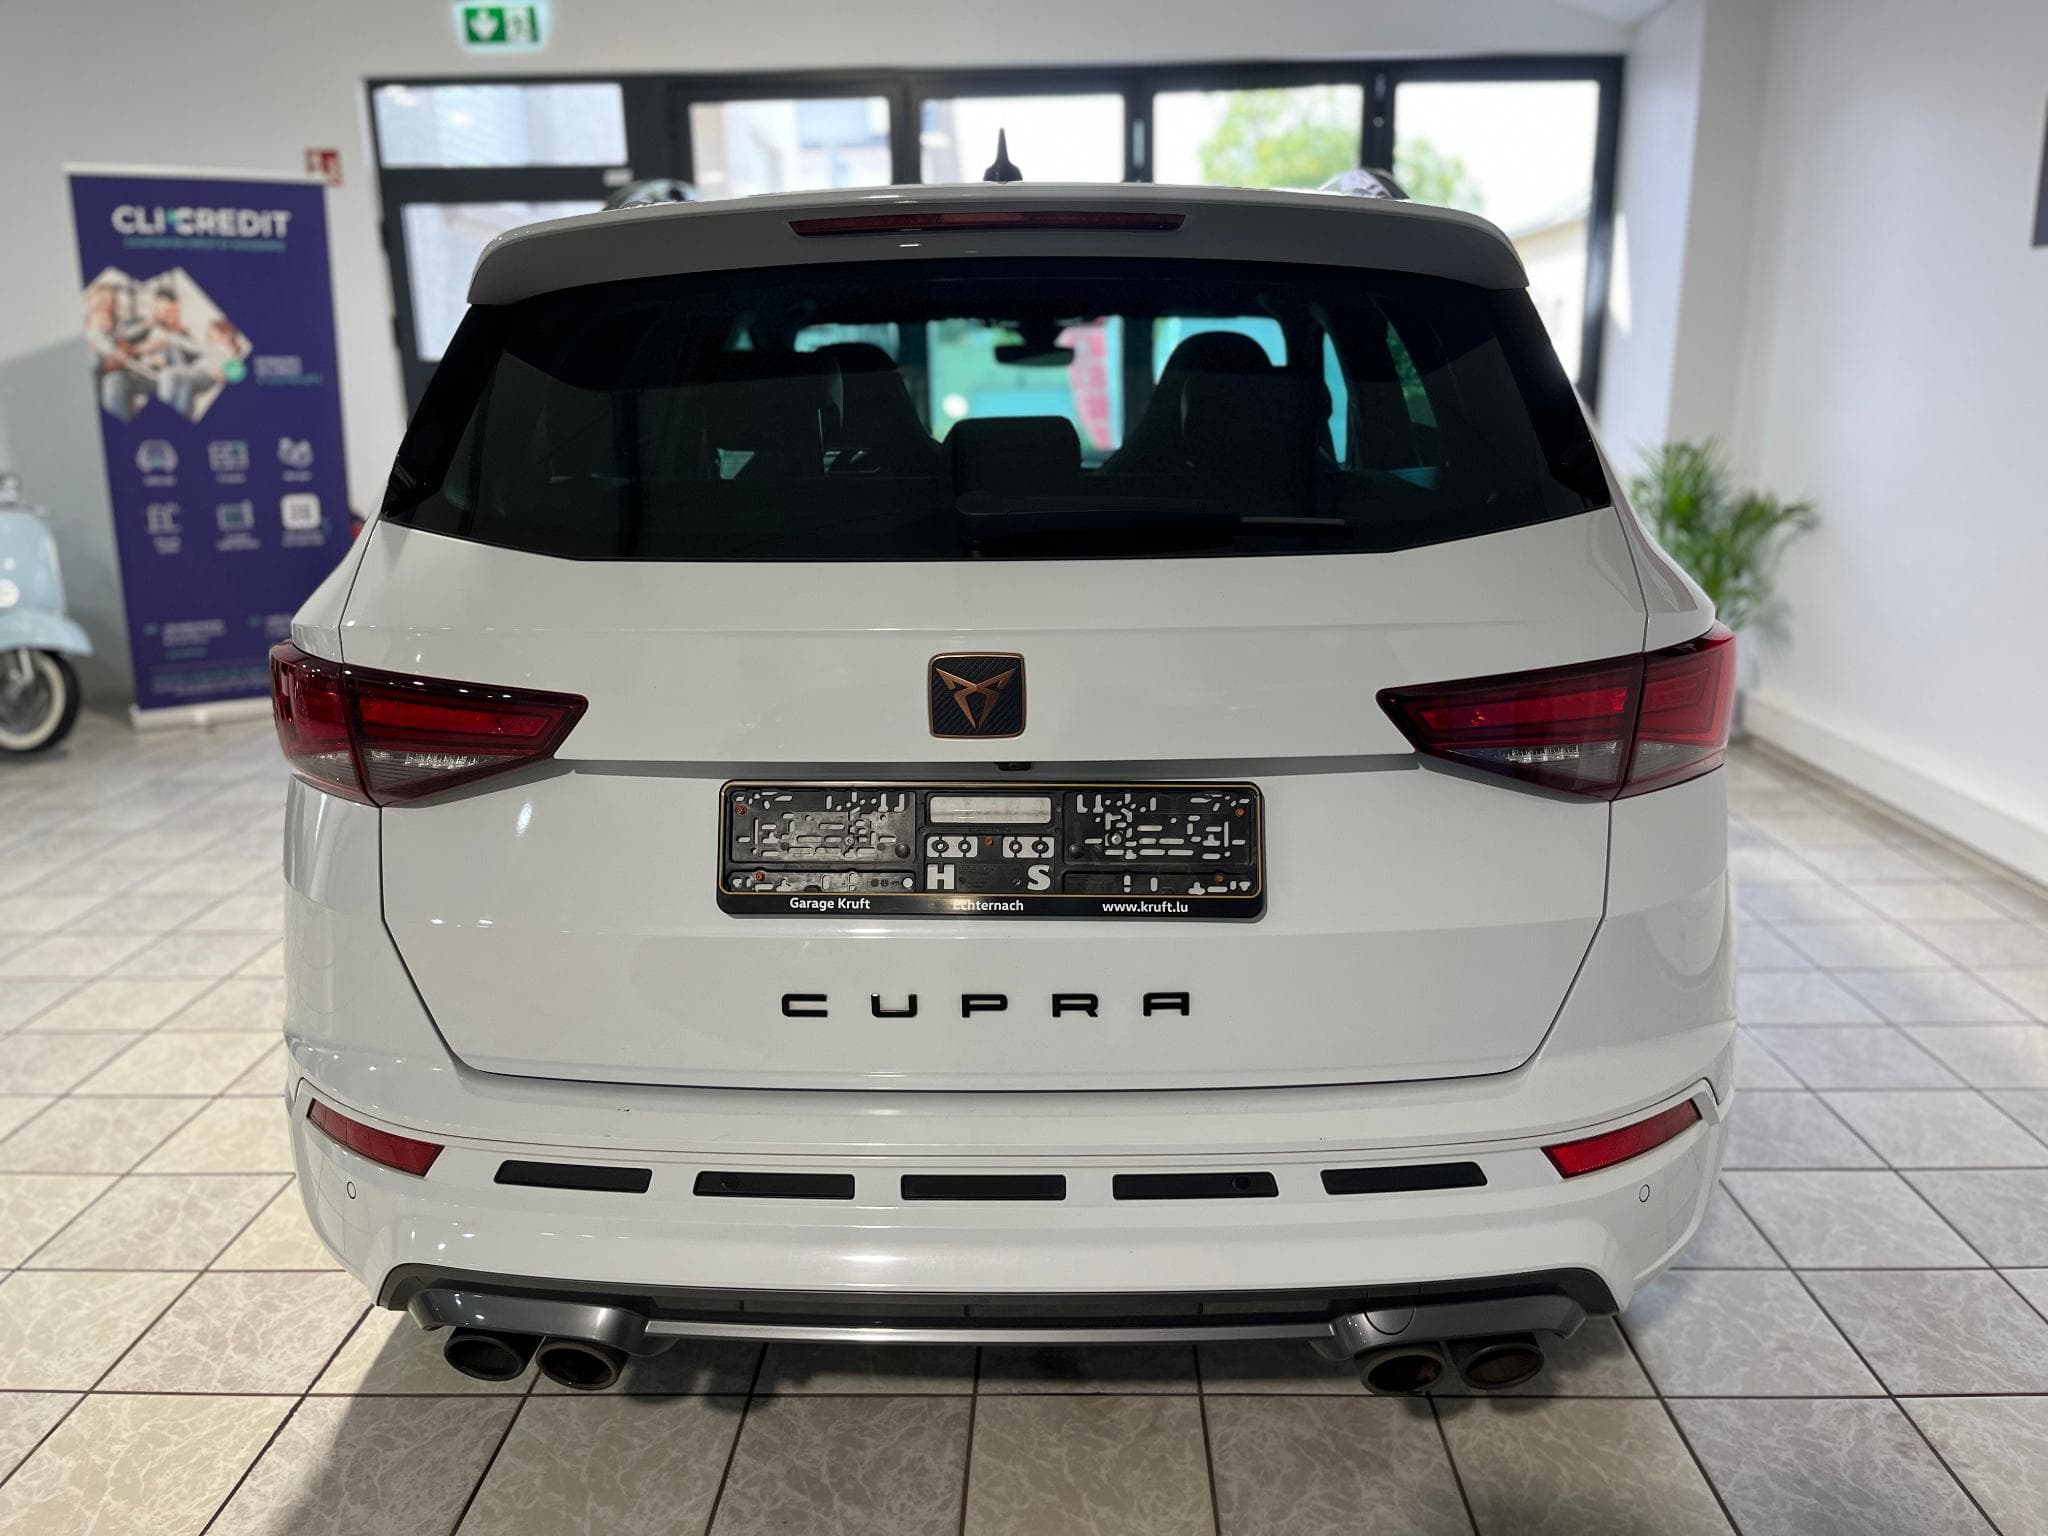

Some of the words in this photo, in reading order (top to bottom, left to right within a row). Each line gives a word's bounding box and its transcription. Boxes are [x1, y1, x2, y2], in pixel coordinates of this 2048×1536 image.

[926, 863, 955, 890] H
[1027, 864, 1051, 891] S
[789, 897, 835, 911] Garage
[838, 897, 871, 910] Kruft
[1102, 901, 1189, 913] www.kruft.lu
[781, 992, 1190, 1018] CUPRA
